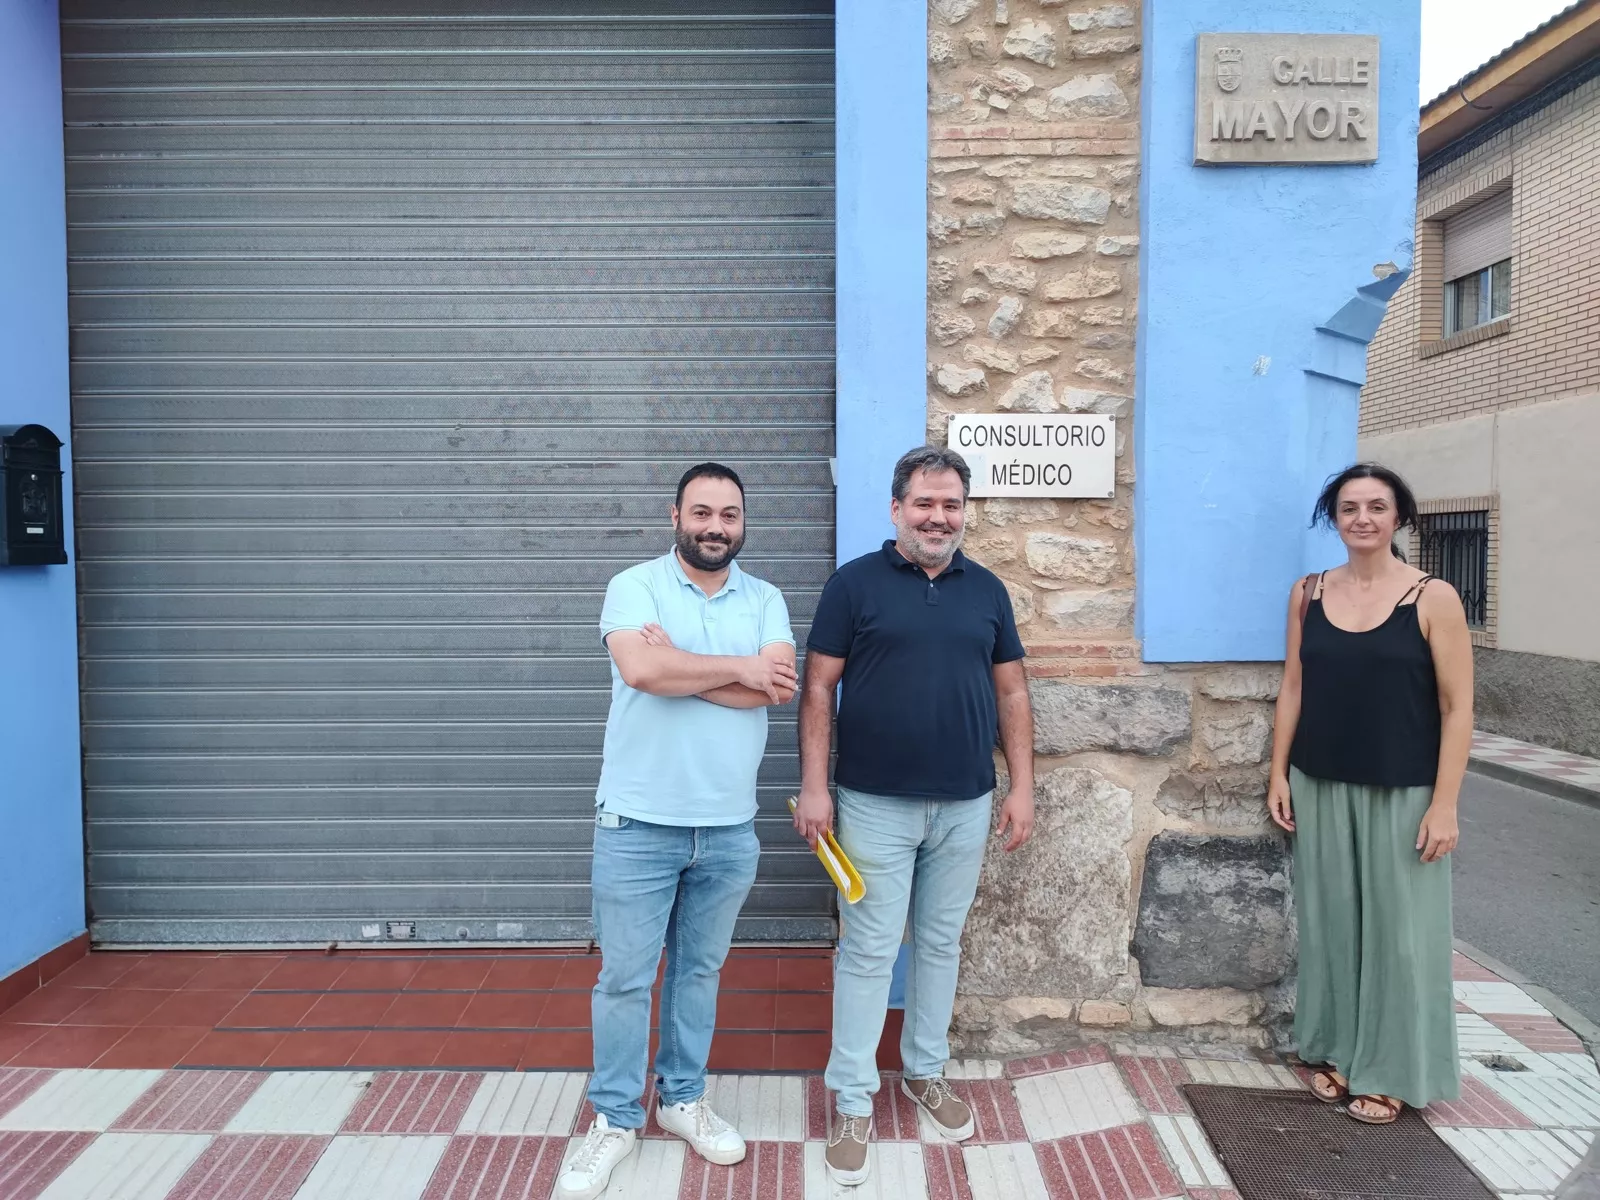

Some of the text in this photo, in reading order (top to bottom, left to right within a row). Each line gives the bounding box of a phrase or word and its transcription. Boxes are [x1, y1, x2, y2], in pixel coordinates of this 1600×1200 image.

[1271, 55, 1369, 86] CALLE
[1211, 99, 1367, 141] MAYOR
[958, 424, 1106, 447] CONSULTORIO
[991, 458, 1073, 486] MÉDICO
